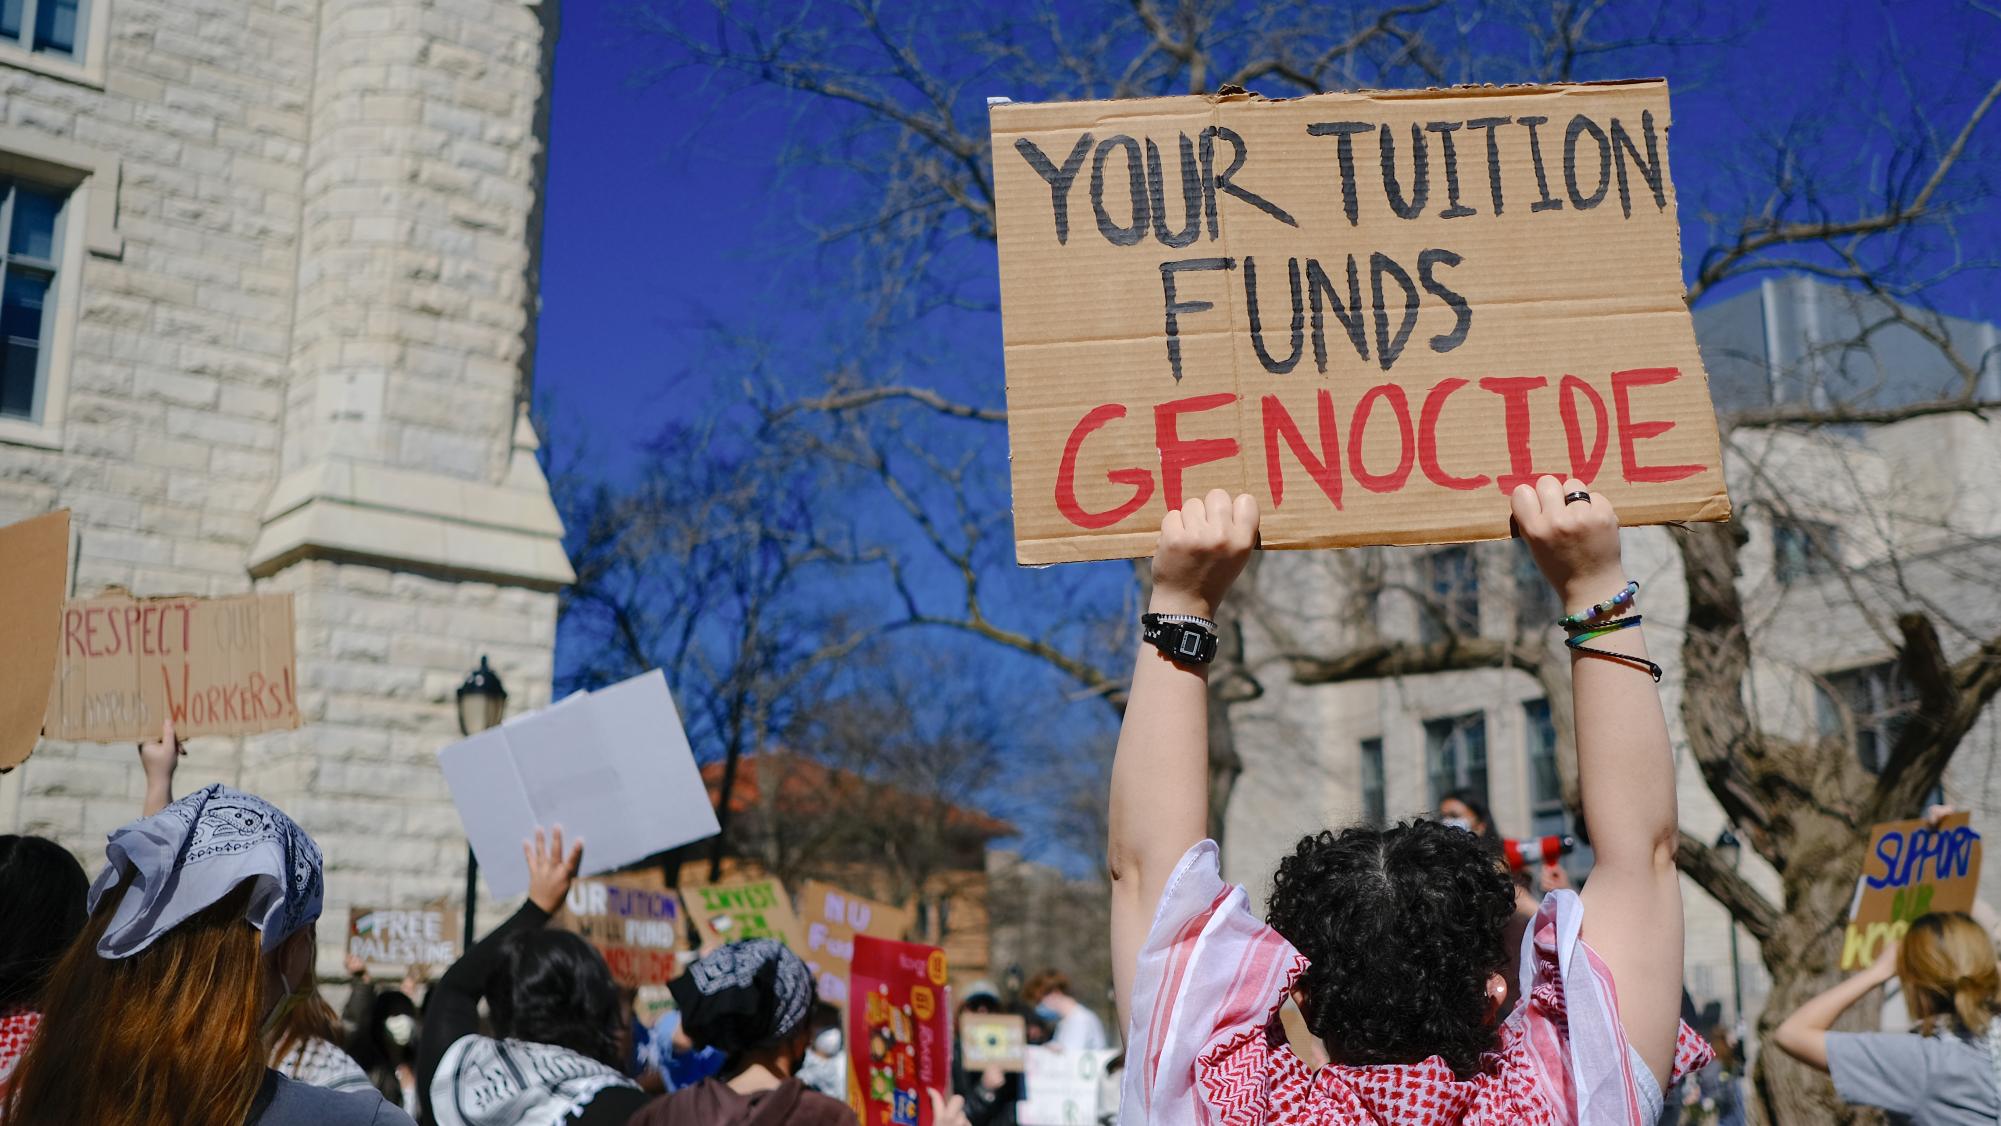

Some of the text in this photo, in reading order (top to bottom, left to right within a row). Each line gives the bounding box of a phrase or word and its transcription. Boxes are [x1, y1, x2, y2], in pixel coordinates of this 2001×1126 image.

[1015, 110, 1667, 248] YOUR TUITION
[1159, 248, 1473, 383] FUNDS
[1054, 366, 1708, 529] GENOCIDE
[65, 604, 197, 657] RESPECT
[161, 661, 294, 725] WORKERS!
[1867, 826, 1981, 889] SUPPORT
[698, 883, 779, 911] INVEST
[823, 890, 873, 933] NU
[350, 935, 456, 965] PALESTINE
[370, 909, 443, 941] FREE
[624, 917, 675, 949] FUND
